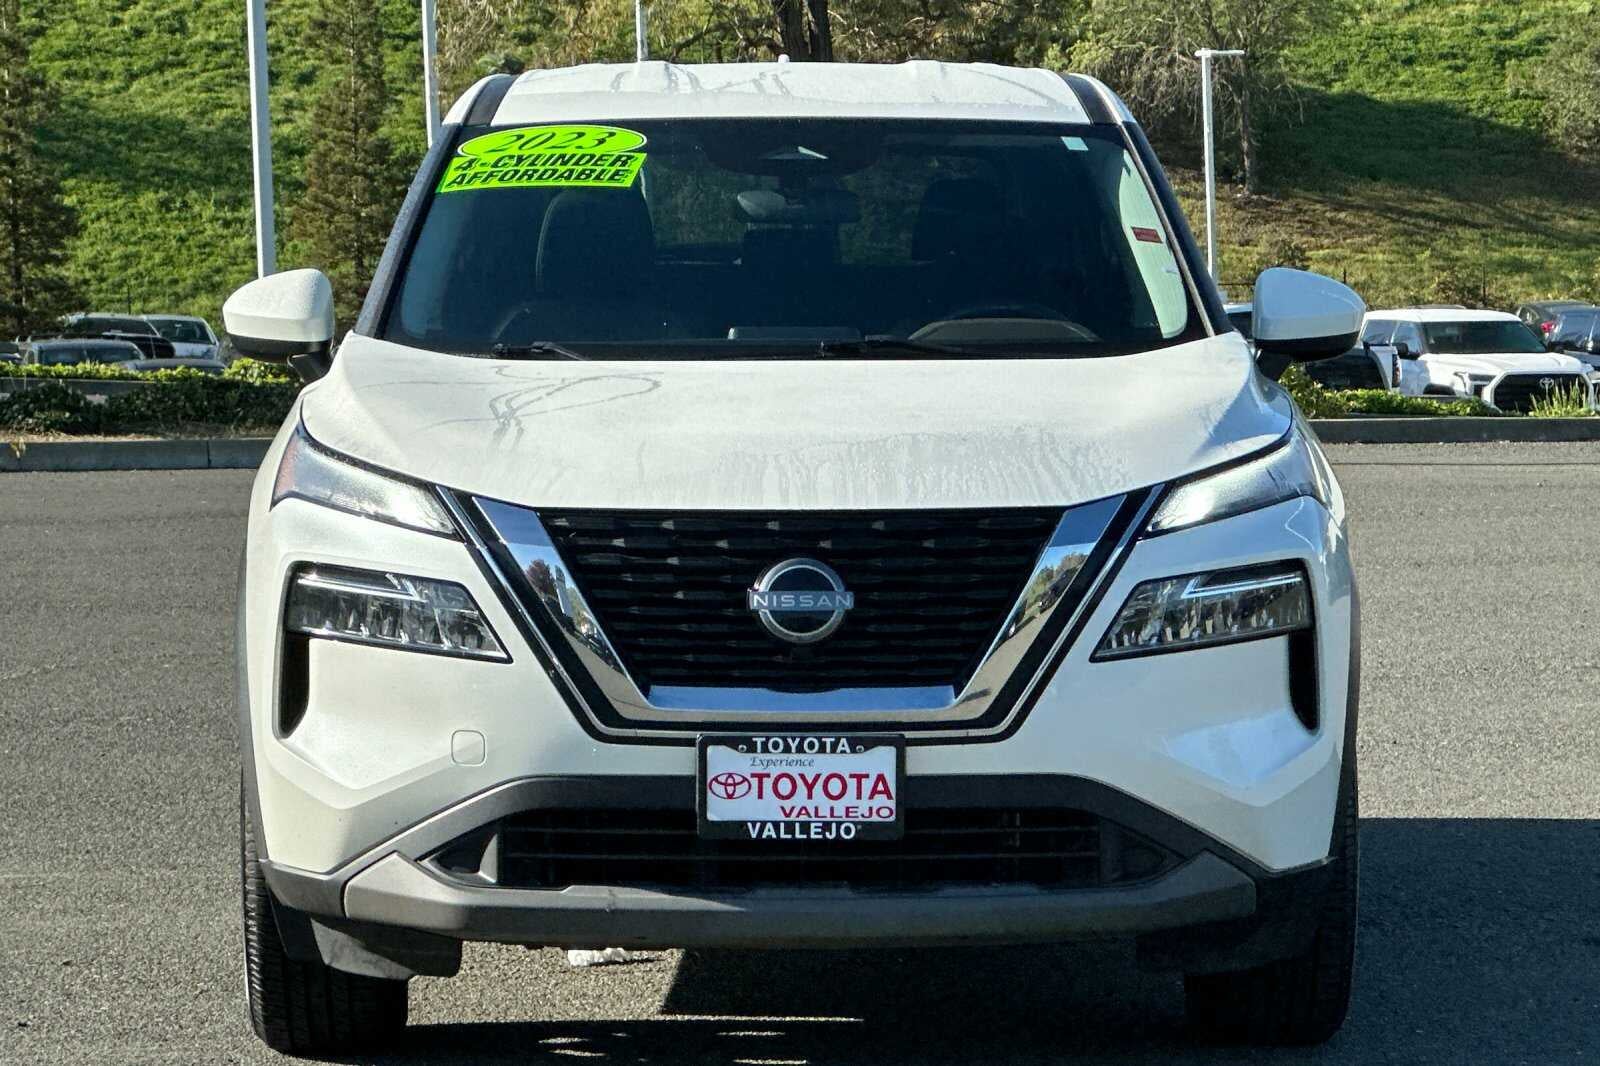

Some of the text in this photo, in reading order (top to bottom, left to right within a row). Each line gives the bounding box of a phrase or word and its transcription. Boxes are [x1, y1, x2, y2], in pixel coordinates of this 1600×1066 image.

[484, 131, 617, 153] 2023
[453, 153, 633, 172] 4-CYLINDER
[445, 168, 627, 188] AFFORDABLE
[753, 594, 851, 607] NISSAN
[752, 737, 851, 753] TOYOTA
[749, 756, 815, 769] Experience
[750, 772, 894, 801] TOYOTA
[779, 805, 894, 819] VALLEJO
[747, 822, 856, 840] VALLEJO
